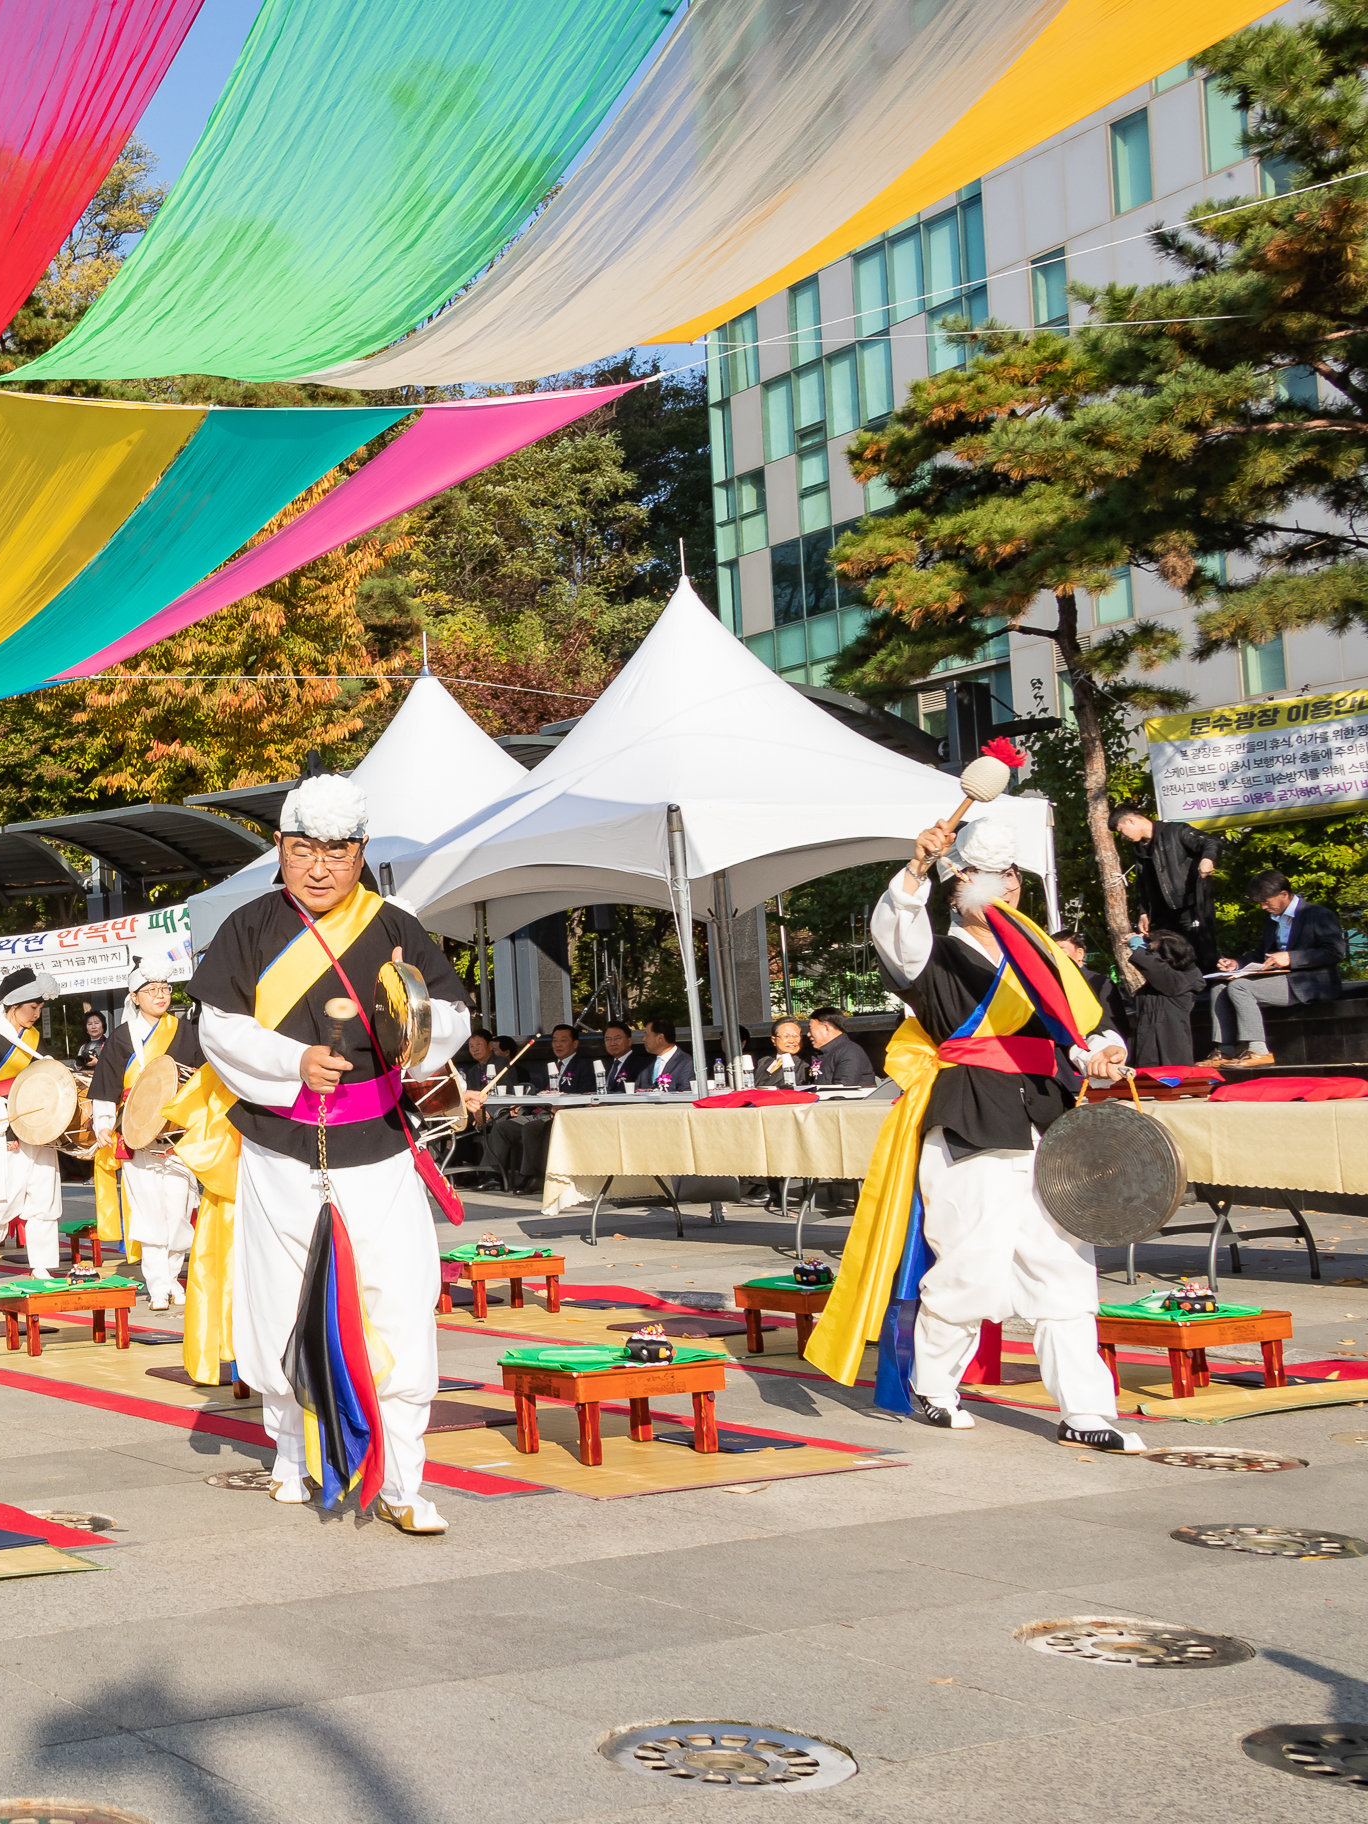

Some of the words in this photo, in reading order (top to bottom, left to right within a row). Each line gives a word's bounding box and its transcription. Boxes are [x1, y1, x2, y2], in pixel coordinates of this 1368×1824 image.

[1190, 708, 1280, 735] 분수광장
[1180, 749, 1189, 760] 본
[1190, 746, 1222, 760] 광장은
[1224, 739, 1267, 755] 주민들의
[1269, 736, 1294, 750] 휴식,
[1295, 731, 1329, 745] 여가를
[1332, 727, 1355, 740] 위한
[1164, 763, 1218, 778] 스케이트보드
[1219, 758, 1251, 773] 이용시
[1253, 753, 1296, 769] 보행자와
[1299, 748, 1332, 764] 충돌에
[1161, 783, 1196, 797] 안전사고
[1197, 780, 1217, 793] 예방
[1218, 779, 1229, 791] 및
[1232, 775, 1264, 789] 스탠드
[1264, 768, 1320, 785] 파손방지를
[1322, 764, 1346, 778] 위해
[1182, 795, 1242, 811] 스케이트보드
[1242, 791, 1276, 804] 이용을
[1277, 785, 1322, 801] 금지하여
[1324, 780, 1359, 796] 주시기
[57, 917, 139, 948] 한복반
[52, 952, 122, 968] 과거급제까지
